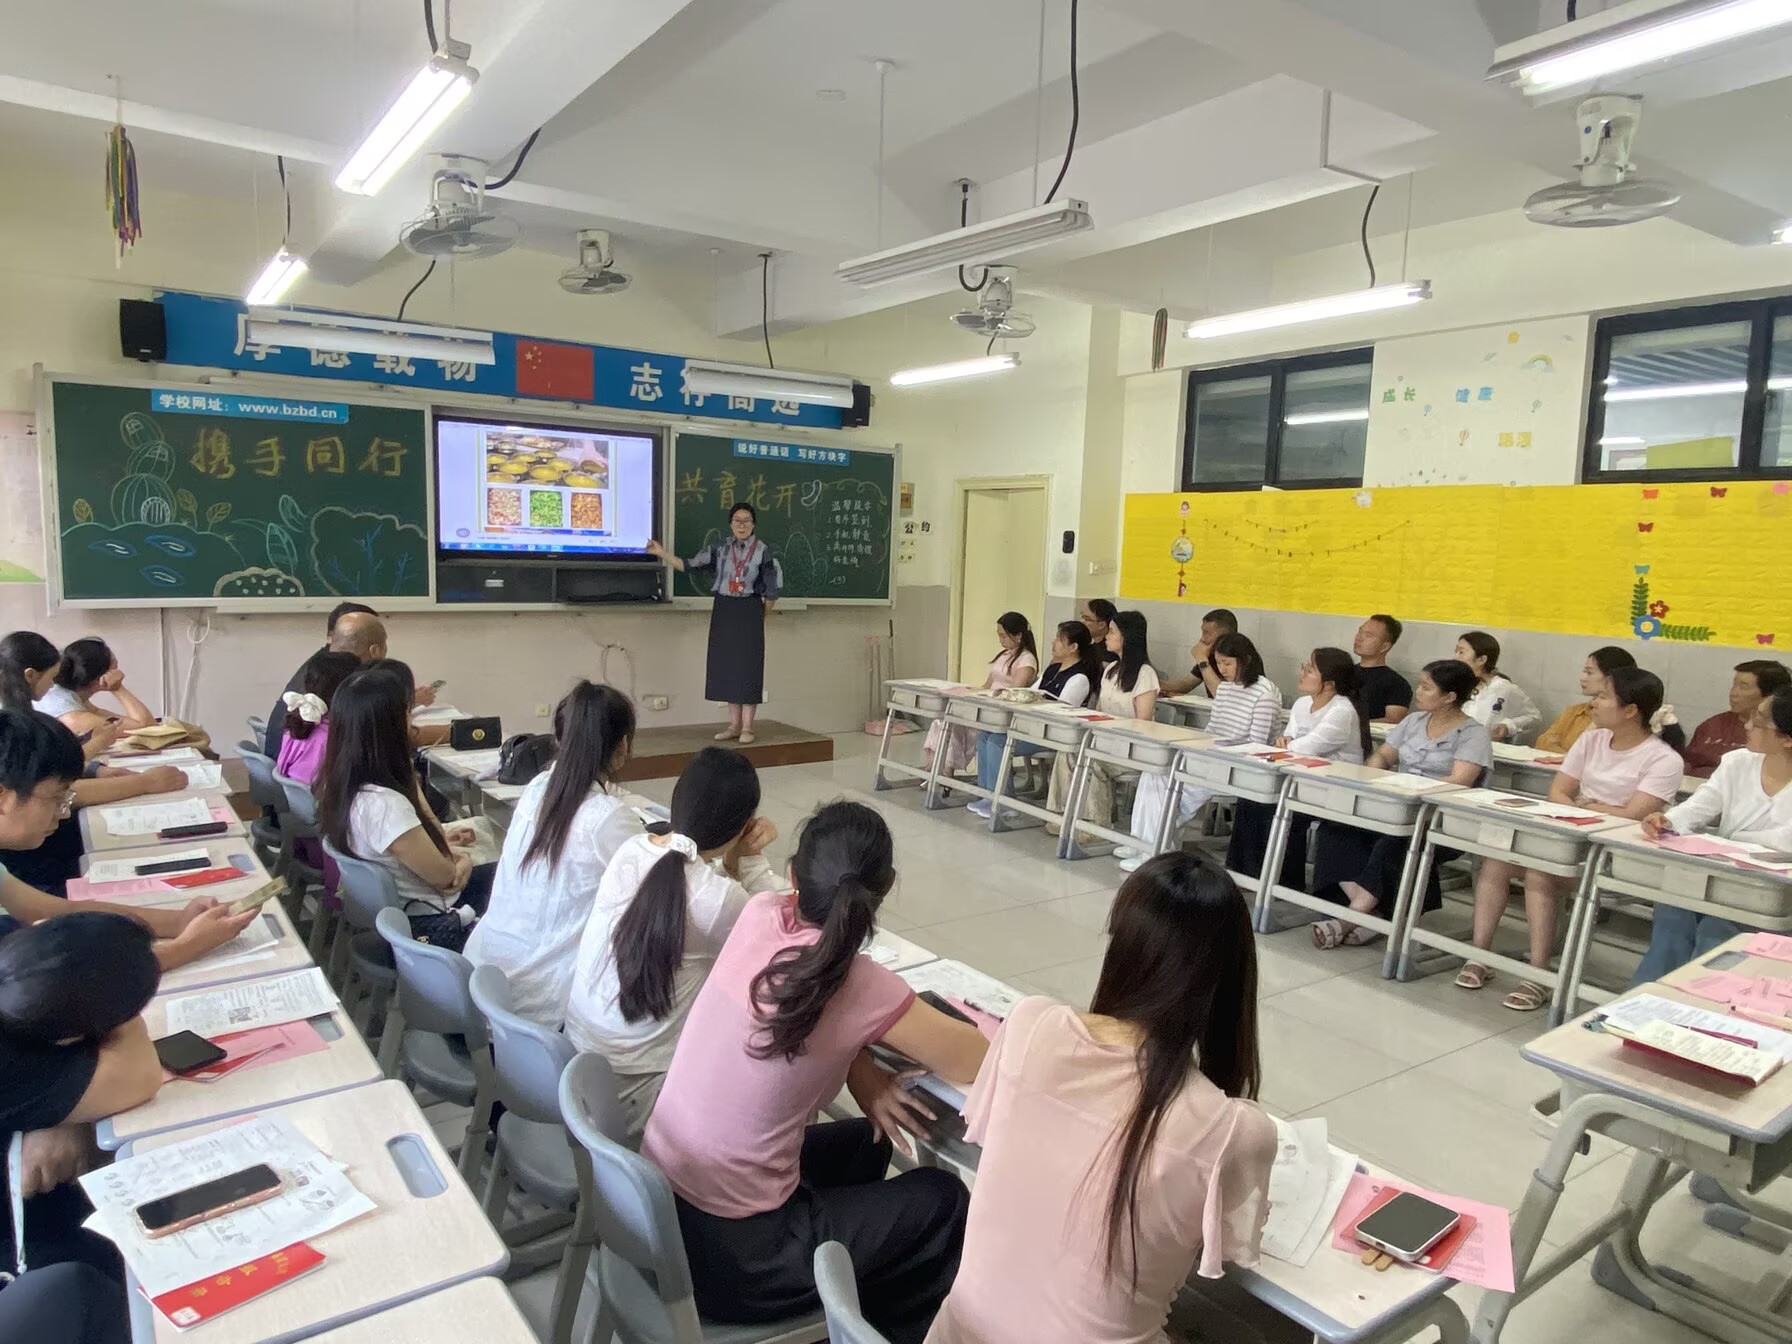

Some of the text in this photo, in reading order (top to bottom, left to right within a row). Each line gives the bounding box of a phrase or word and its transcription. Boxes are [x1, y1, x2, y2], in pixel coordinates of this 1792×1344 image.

[238, 403, 337, 419] www.bzbd.cn
[190, 427, 408, 479] 携手同行
[737, 442, 847, 463] 说好普通话 写好方块字
[676, 467, 797, 518] 共育花开
[905, 521, 931, 534] 公约
